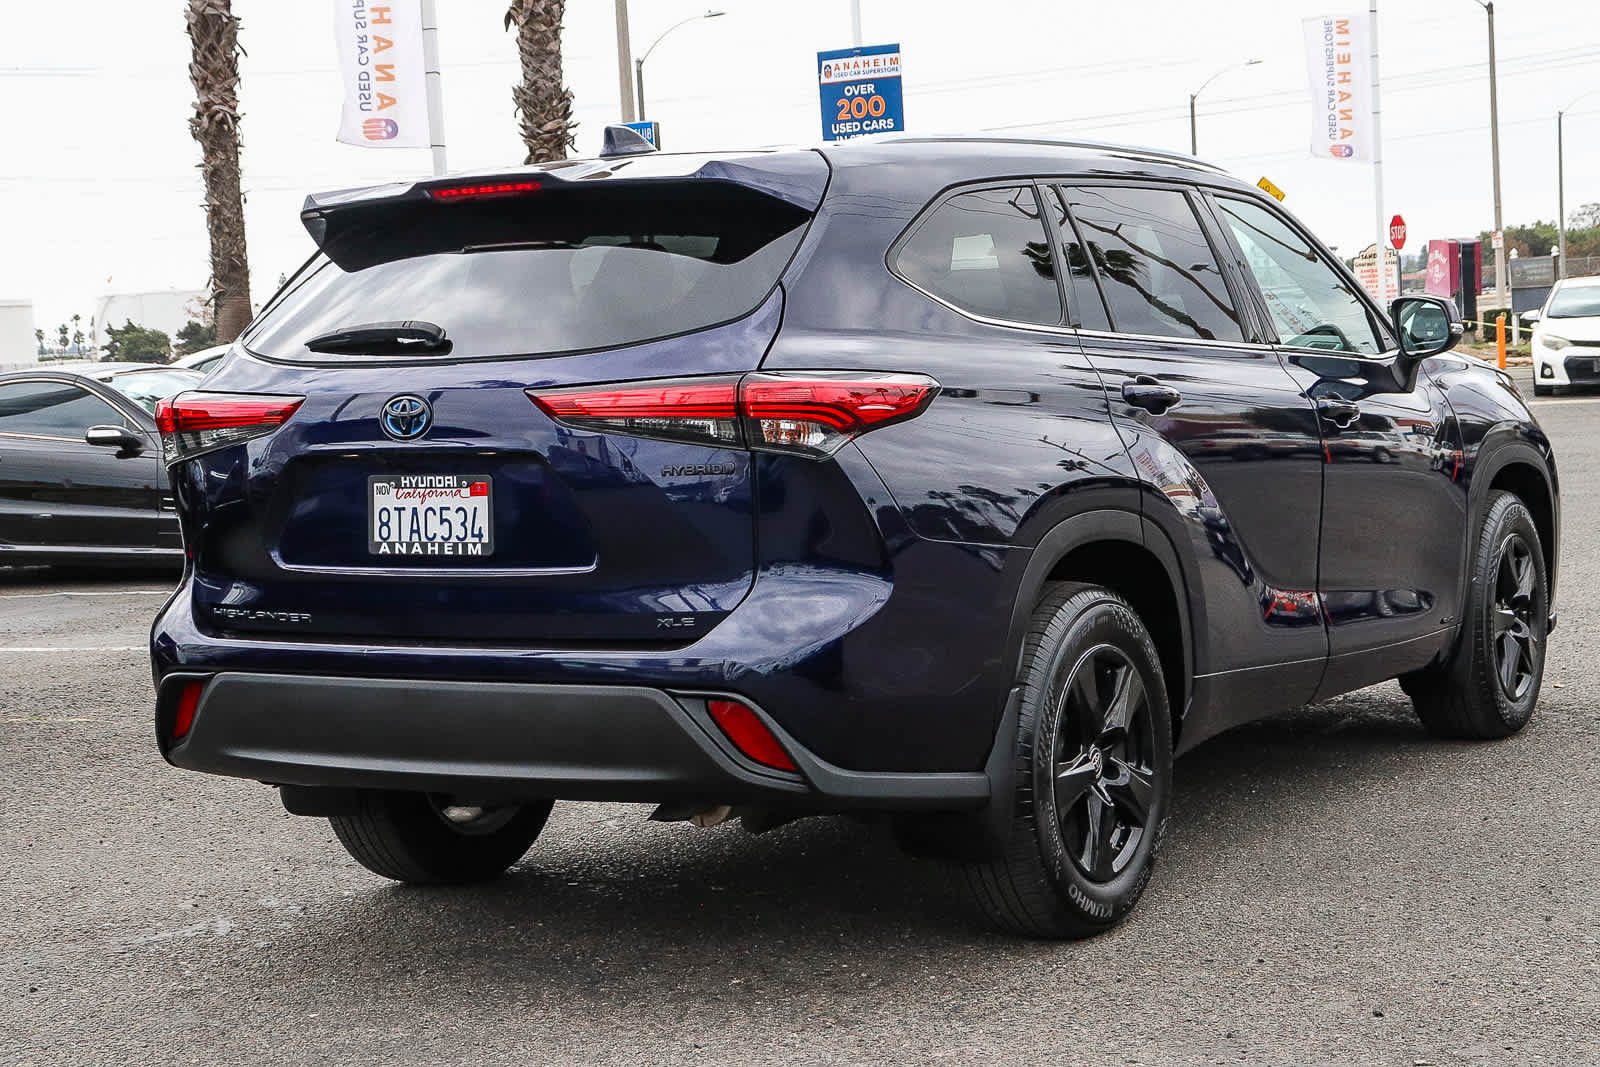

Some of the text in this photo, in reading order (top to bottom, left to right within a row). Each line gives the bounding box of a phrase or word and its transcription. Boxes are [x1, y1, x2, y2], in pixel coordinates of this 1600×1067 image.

[833, 56, 899, 72] ANAHEIM
[833, 66, 899, 79] USED CAR SUPERSTORE
[844, 83, 875, 96] OVER
[836, 95, 886, 120] 200
[831, 118, 894, 134] USED CARS
[1390, 225, 1406, 241] STOP
[400, 475, 457, 488] HYUNDAI
[375, 485, 391, 496] NOV
[395, 488, 471, 505] California
[378, 506, 484, 542] 8TAC534
[378, 542, 483, 555] ANAHEIM
[213, 607, 312, 623] HIGHLANDER
[656, 617, 695, 628] XLE
[1068, 883, 1113, 918] KUMHO
